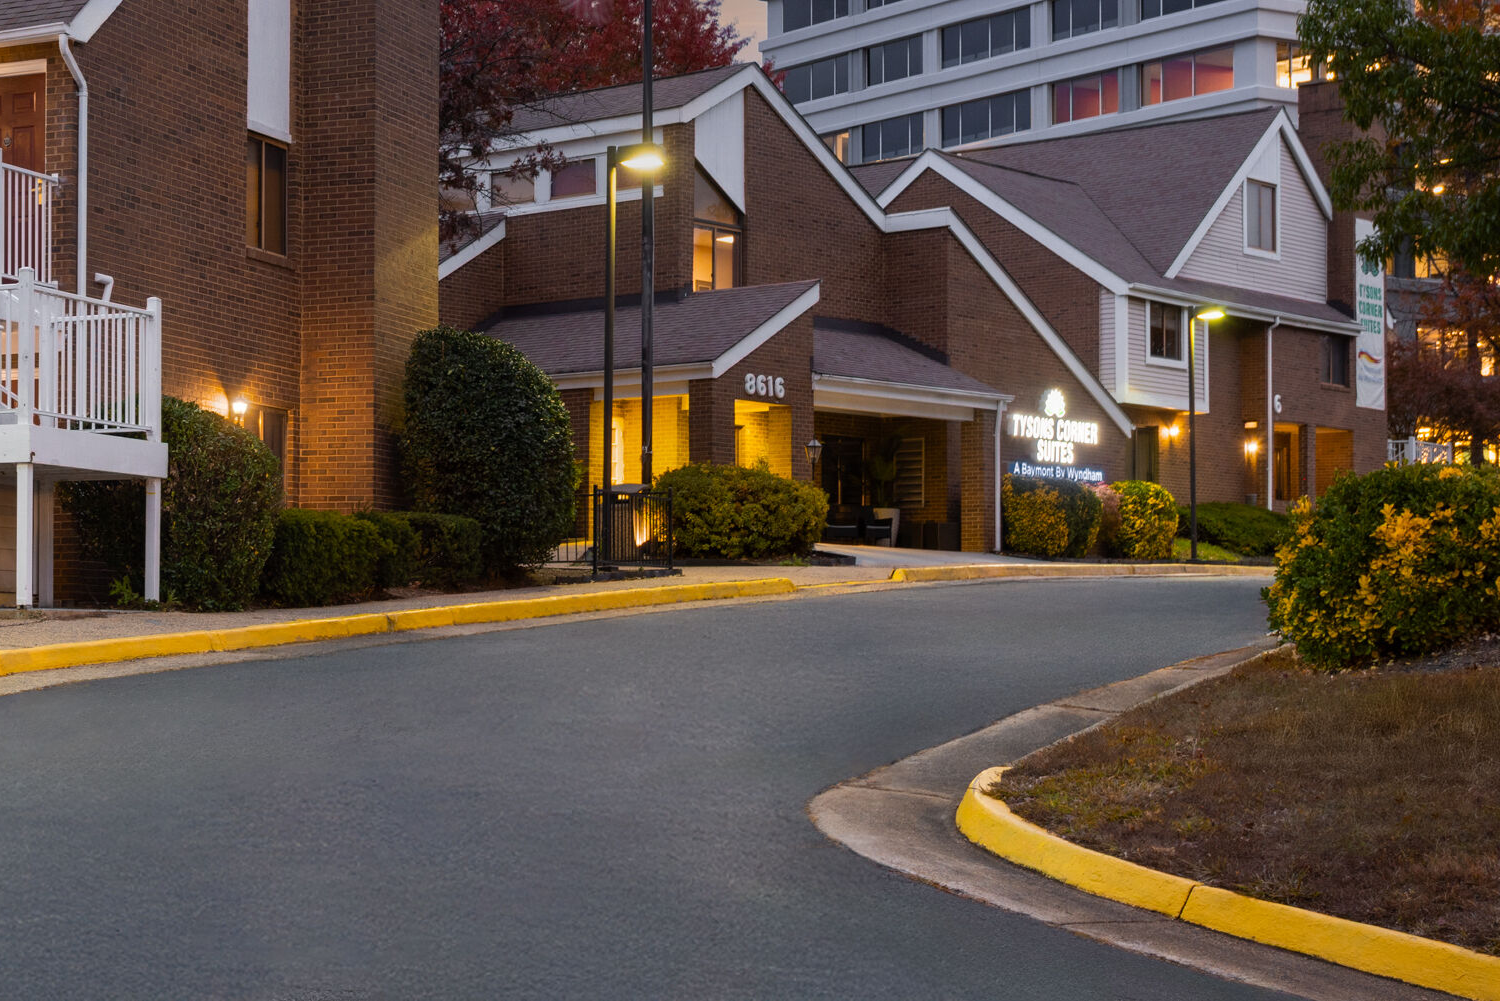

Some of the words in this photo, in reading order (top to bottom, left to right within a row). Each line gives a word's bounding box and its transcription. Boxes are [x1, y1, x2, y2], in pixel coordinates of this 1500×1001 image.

[1358, 301, 1383, 318] CORNER
[744, 373, 785, 398] 8616
[1274, 394, 1282, 413] 6
[1013, 414, 1054, 439] TYSONS
[1056, 419, 1098, 444] CORNER
[1037, 439, 1073, 463] SUITES
[1013, 462, 1020, 474] A
[1021, 463, 1054, 477] Baymont
[1067, 467, 1102, 481] Wyndham
